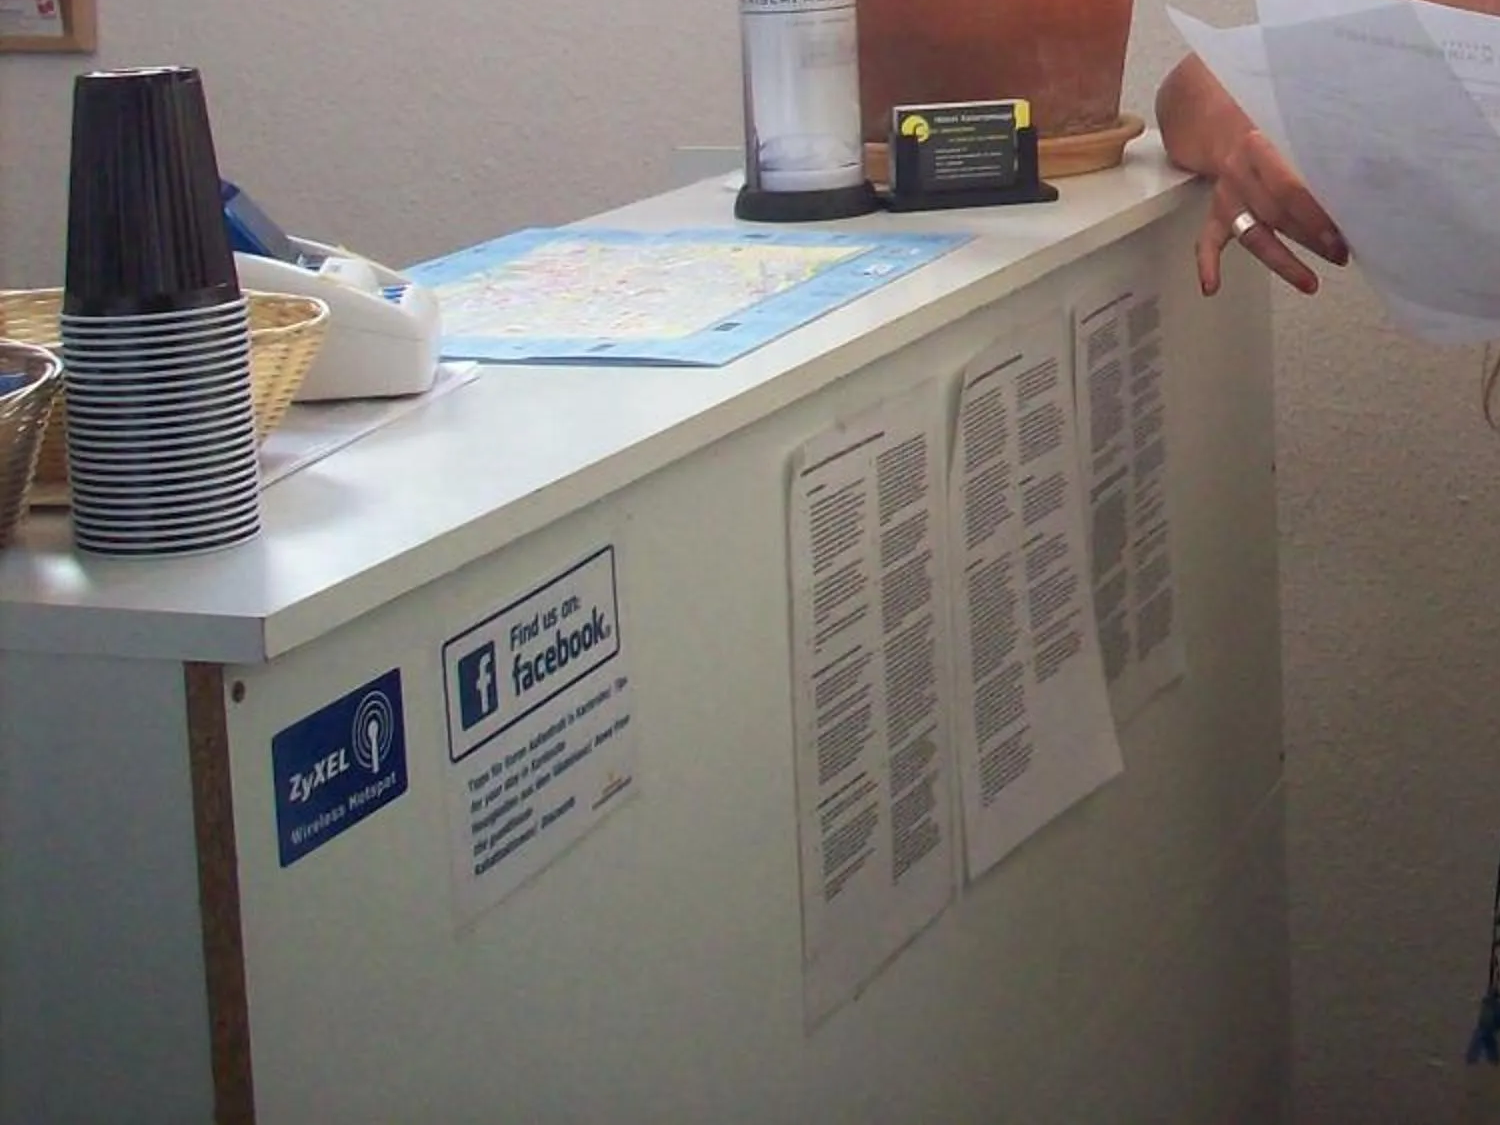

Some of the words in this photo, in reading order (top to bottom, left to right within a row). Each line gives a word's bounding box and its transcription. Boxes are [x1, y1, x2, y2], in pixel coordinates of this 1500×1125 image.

[510, 611, 539, 651] Find
[543, 607, 557, 630] us
[289, 748, 350, 802] ZyXEL
[291, 805, 345, 844] Wireless
[348, 771, 397, 811] Hotspot
